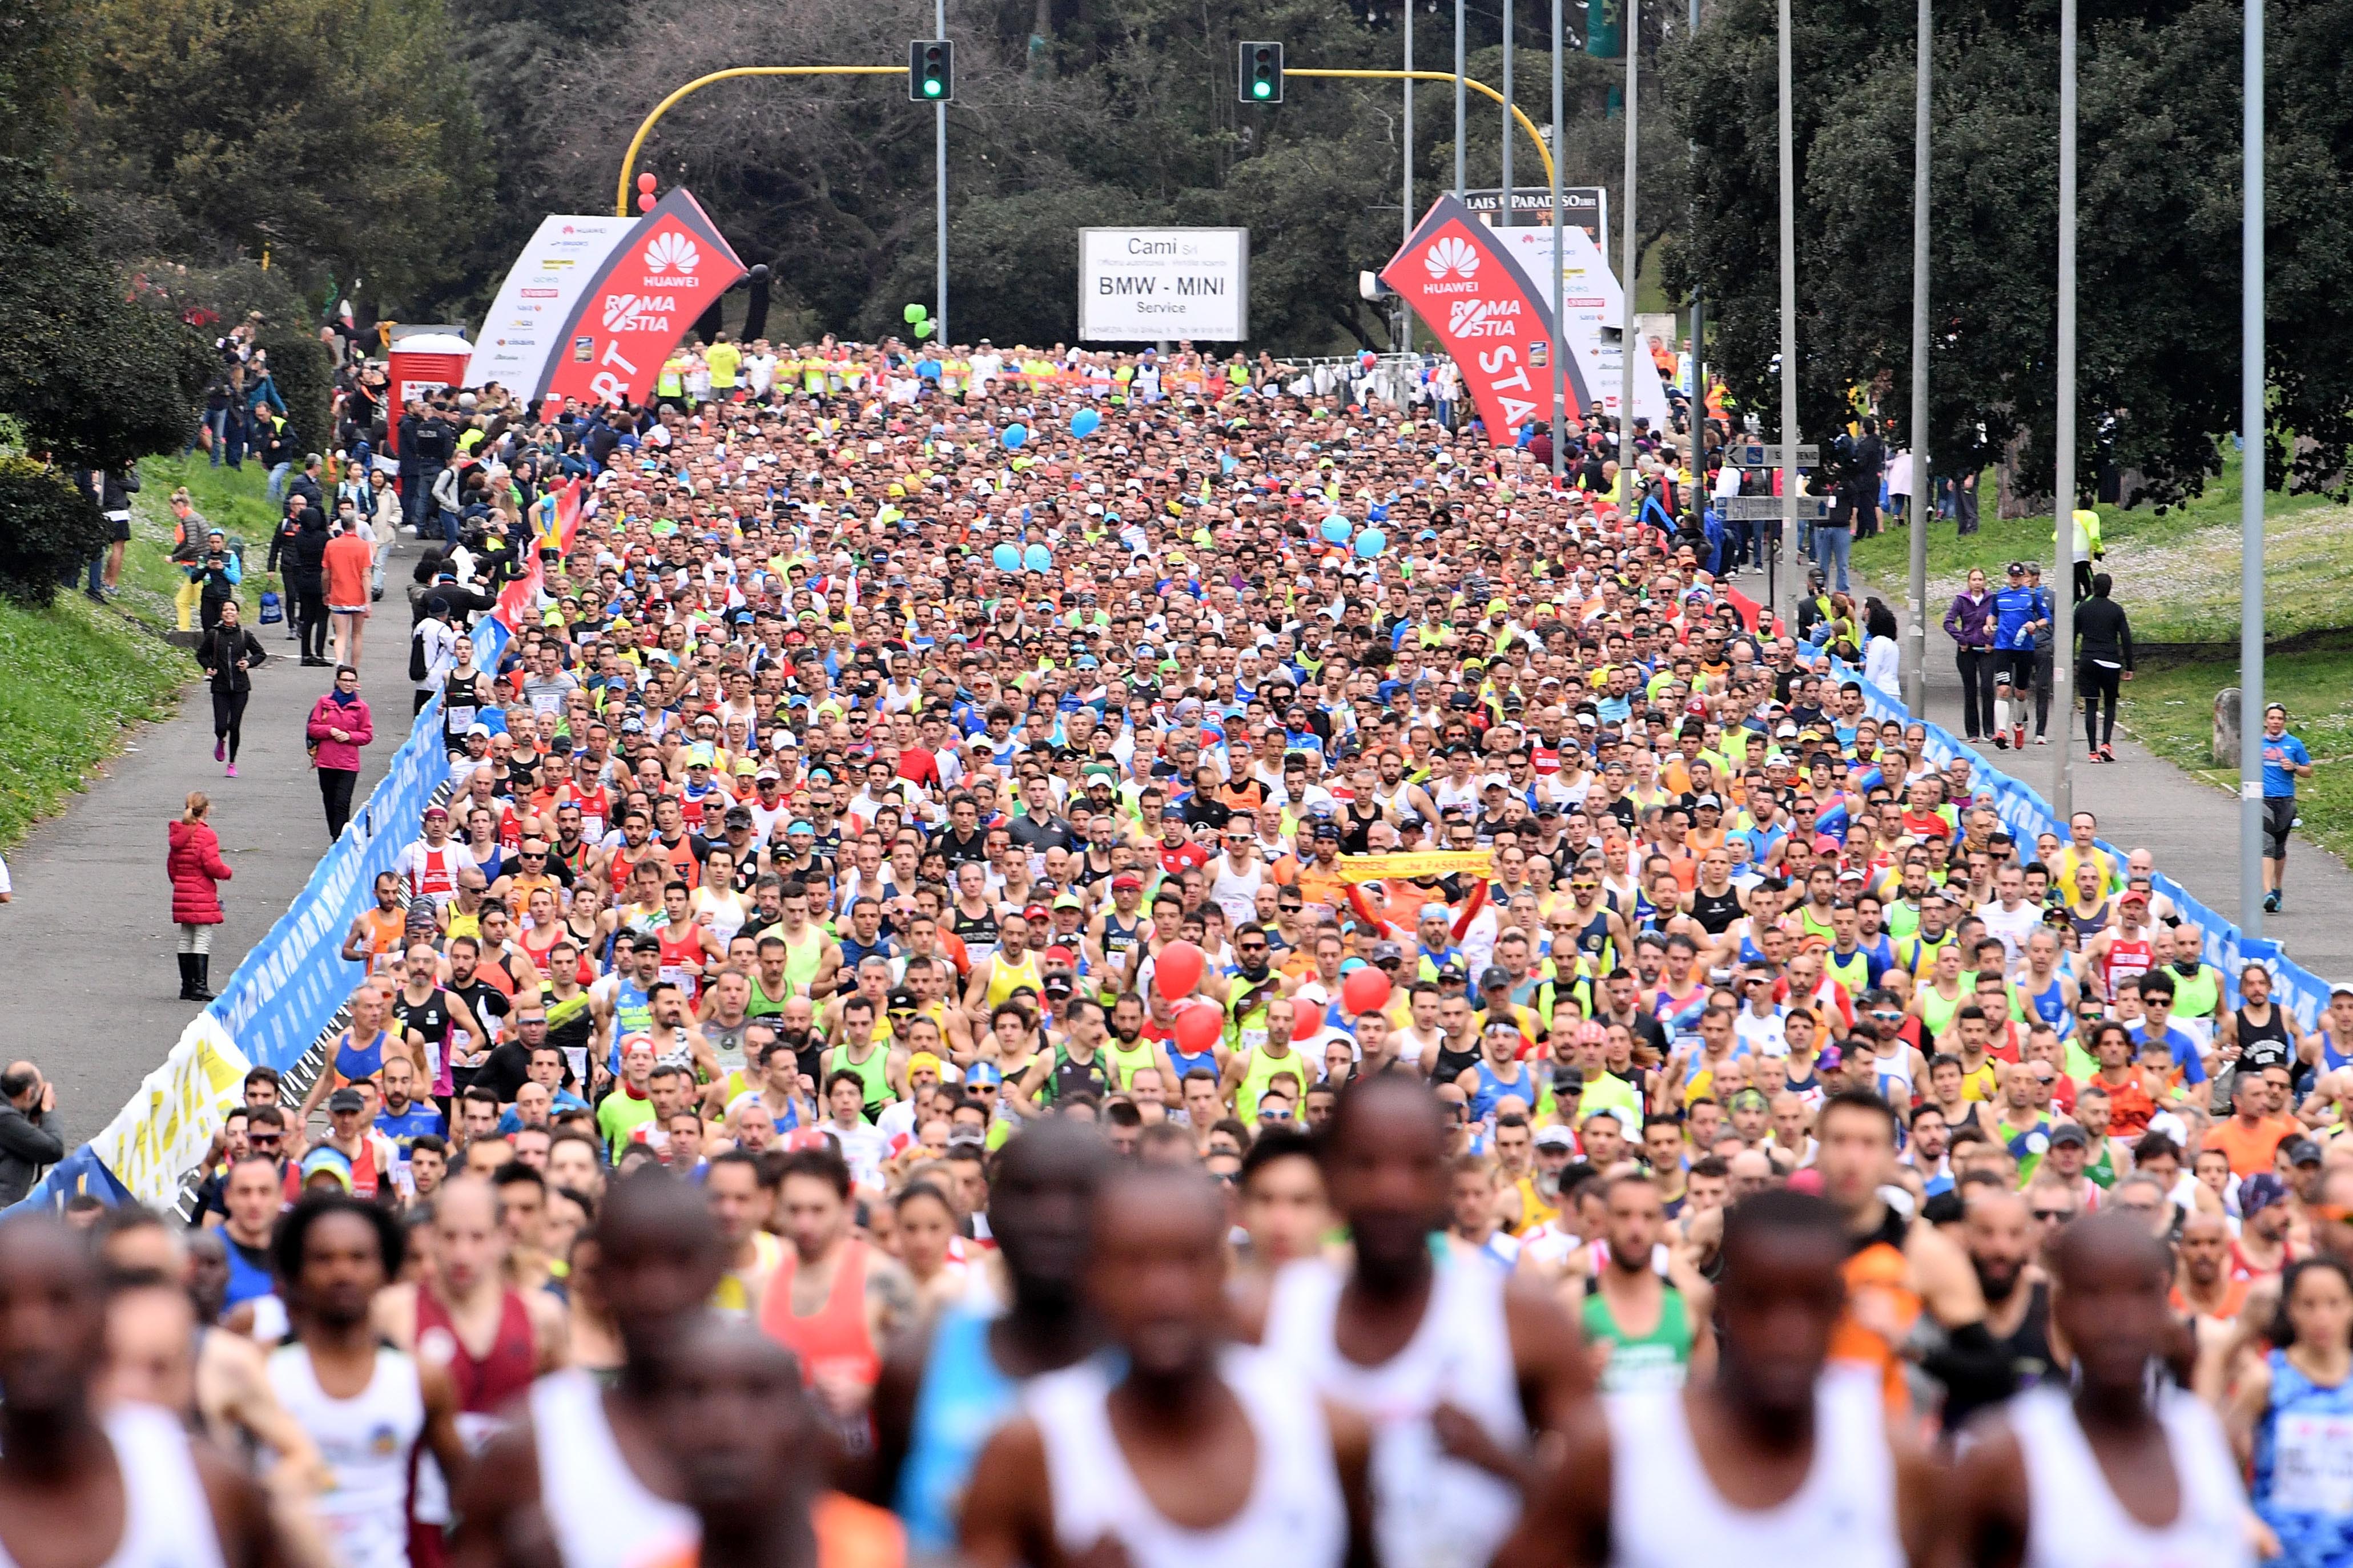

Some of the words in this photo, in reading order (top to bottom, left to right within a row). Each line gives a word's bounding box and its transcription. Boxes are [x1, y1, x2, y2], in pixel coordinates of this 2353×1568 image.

[1511, 195, 1580, 208] PARADSO
[1128, 237, 1177, 255] Cami
[643, 276, 699, 287] HUAWEI
[1100, 277, 1156, 295] BMW
[1177, 277, 1224, 295] MINI
[1423, 281, 1479, 294] HUAWEI
[605, 293, 676, 313] ROMA
[1137, 301, 1186, 313] Service
[1450, 299, 1521, 319] ROMA
